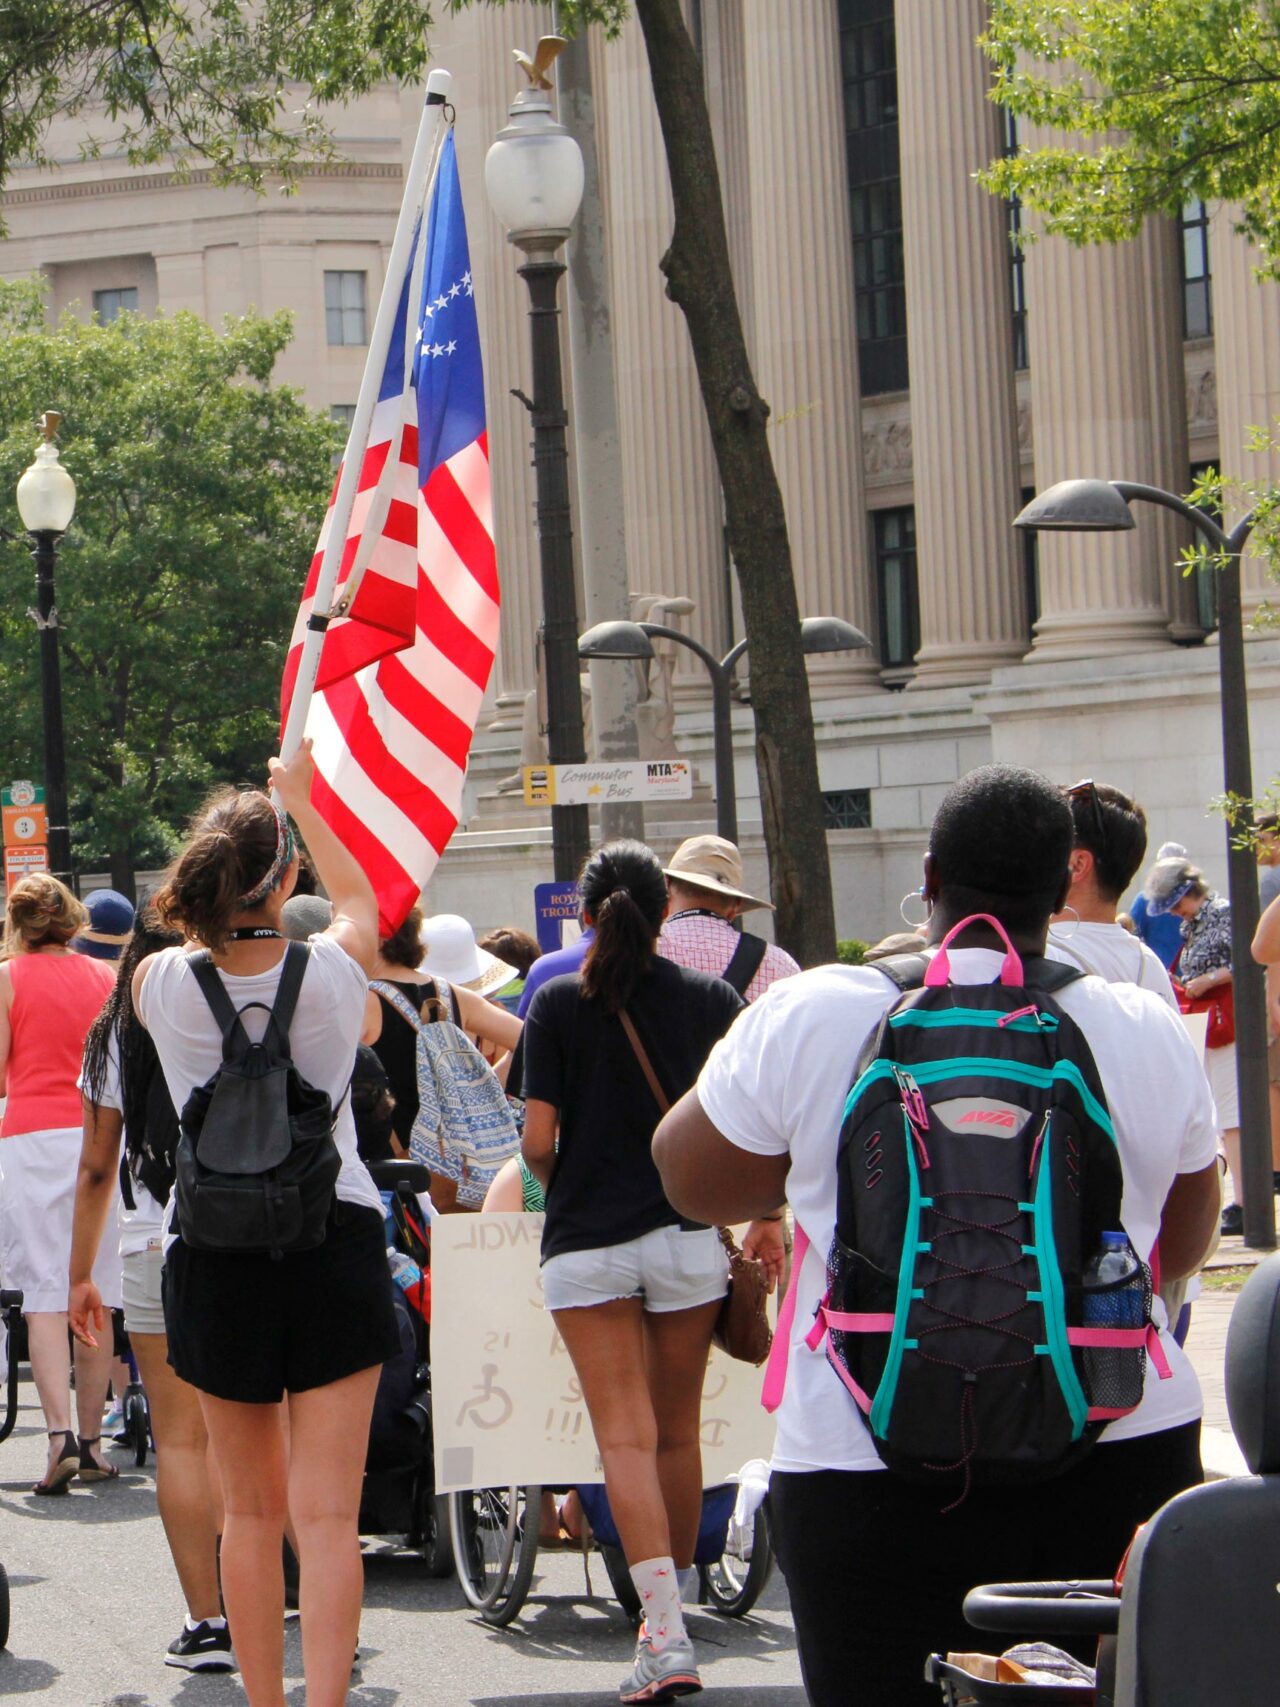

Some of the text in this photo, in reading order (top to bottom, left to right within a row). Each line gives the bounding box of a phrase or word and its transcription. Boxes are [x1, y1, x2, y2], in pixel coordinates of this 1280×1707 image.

[561, 767, 633, 784] Commuter
[647, 763, 672, 777] MTA
[647, 777, 680, 785] Maryland
[606, 783, 634, 798] Bus
[21, 821, 29, 833] 3
[541, 906, 579, 918] TROLL
